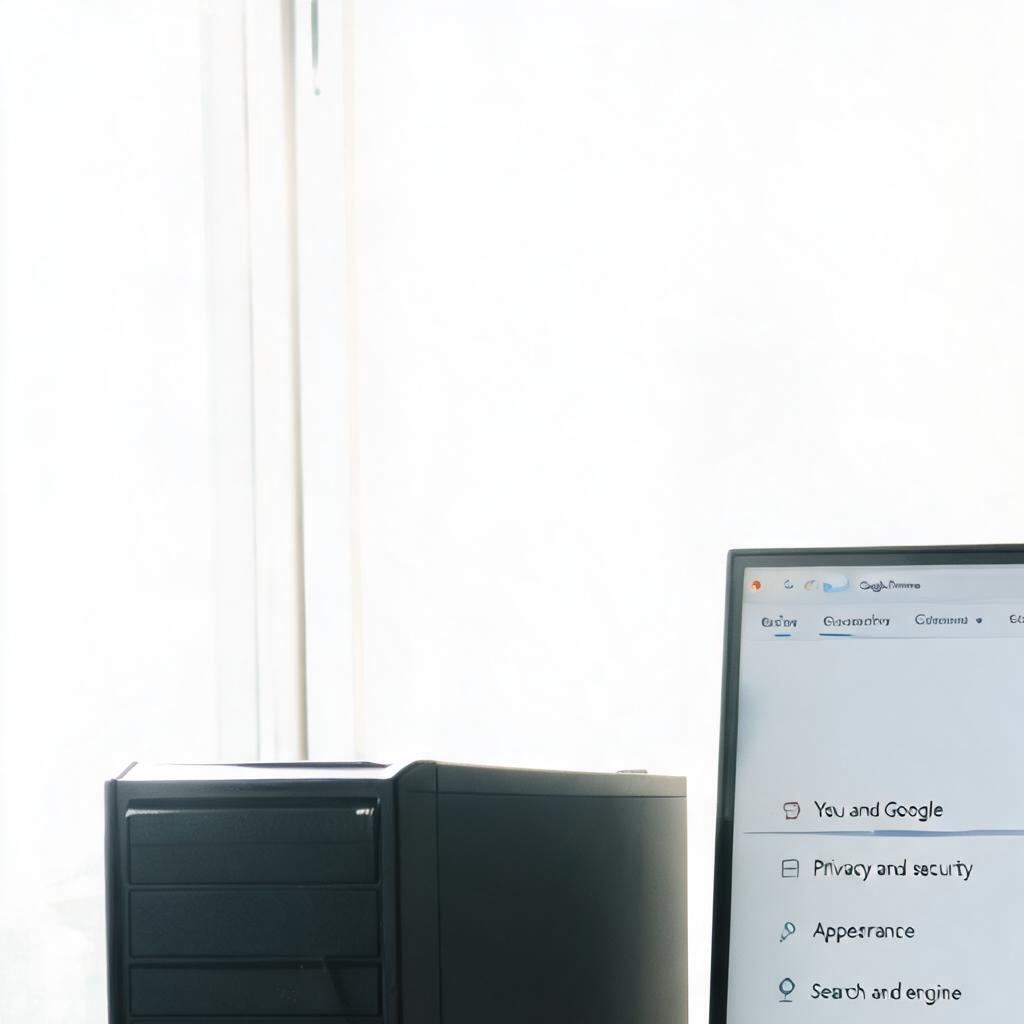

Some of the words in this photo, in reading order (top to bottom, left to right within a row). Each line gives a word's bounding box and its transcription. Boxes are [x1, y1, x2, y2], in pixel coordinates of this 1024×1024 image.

[814, 800, 845, 818] You
[849, 801, 880, 818] and
[884, 800, 944, 822] Google
[813, 858, 872, 881] Privacy
[876, 858, 907, 877] and
